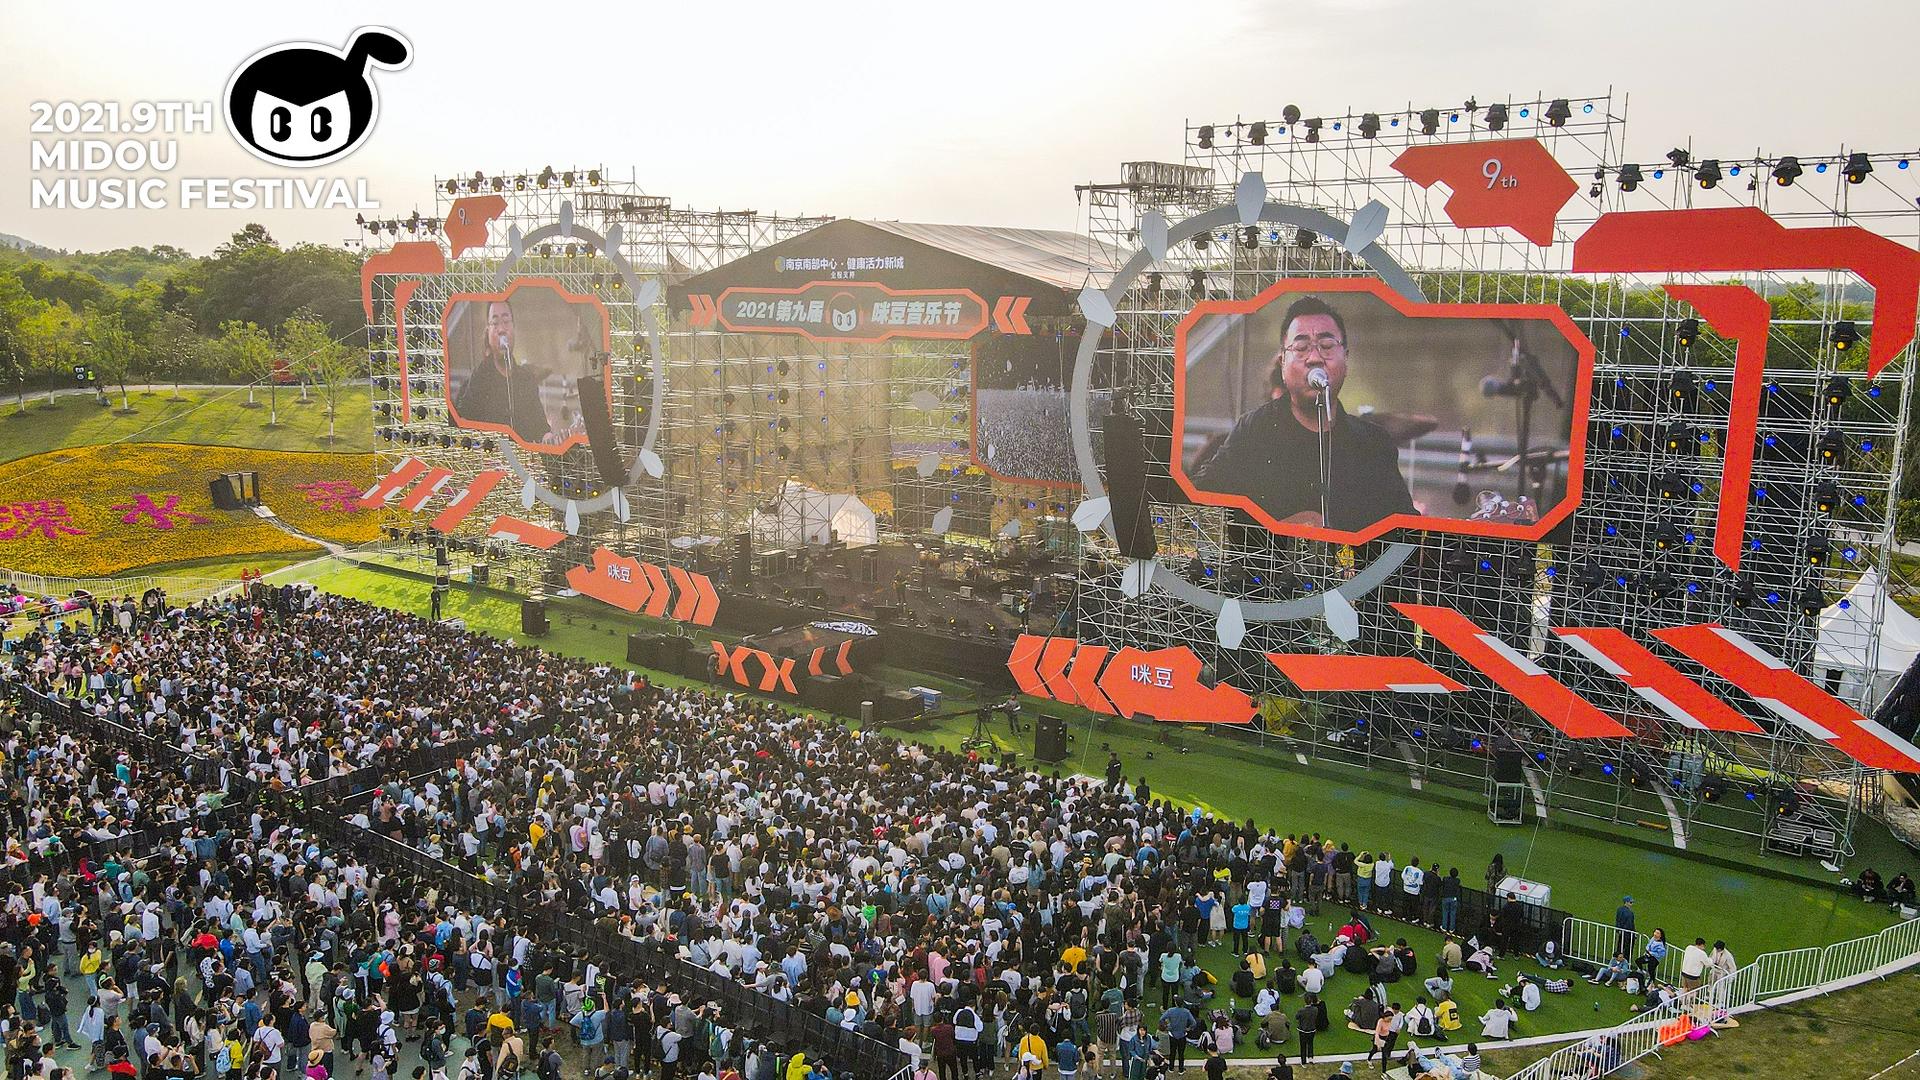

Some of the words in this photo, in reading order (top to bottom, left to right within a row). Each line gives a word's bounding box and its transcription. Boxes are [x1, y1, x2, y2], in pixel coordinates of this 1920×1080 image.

[1482, 158, 1519, 190] 9th
[871, 301, 962, 325] 咪豆音乐节
[607, 564, 632, 583] 咪豆
[1130, 663, 1175, 690] 咪豆
